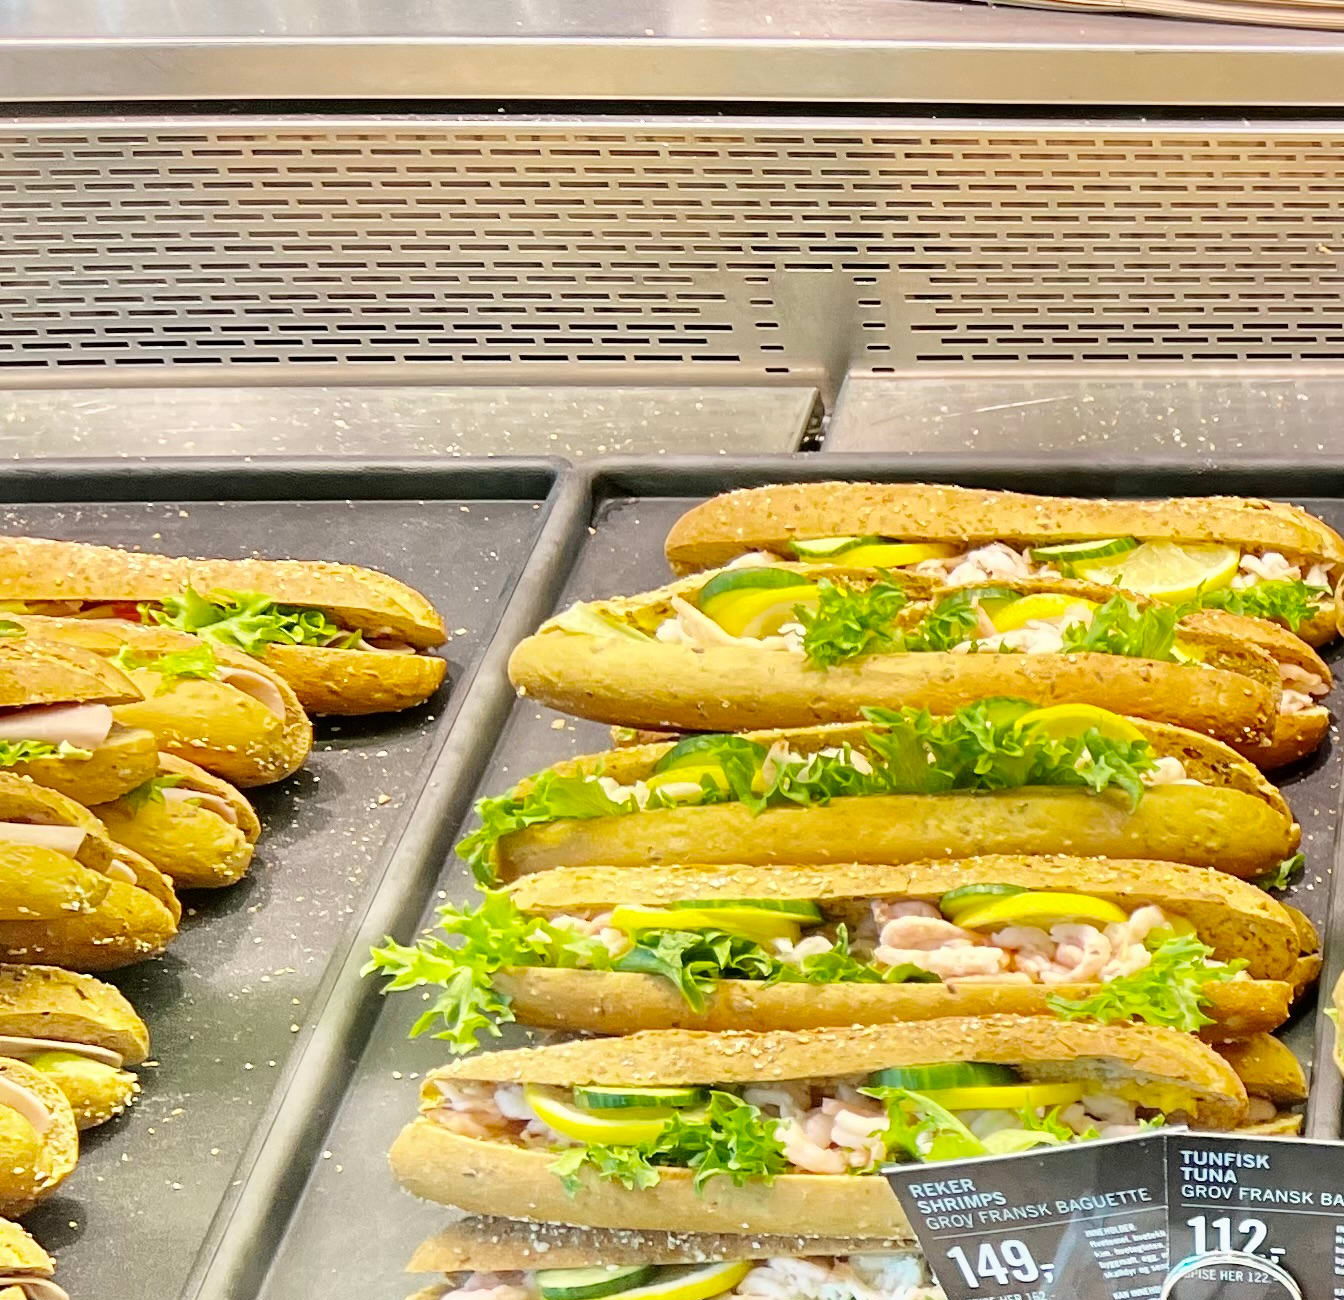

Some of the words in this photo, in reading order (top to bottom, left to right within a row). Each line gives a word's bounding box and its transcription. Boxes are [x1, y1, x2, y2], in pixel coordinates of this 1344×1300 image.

[1179, 1150, 1270, 1169] TUNFISK
[1179, 1167, 1237, 1184] TUNA
[908, 1178, 976, 1198] REKER
[1180, 1184, 1233, 1199] GROV
[1238, 1187, 1315, 1205] FRANSK
[917, 1192, 1007, 1214] SHRIMPS
[926, 1211, 974, 1231] GROV
[980, 1203, 1052, 1225] FRANSK
[1056, 1187, 1152, 1214] BAGUETTE
[1219, 1270, 1243, 1282] HER
